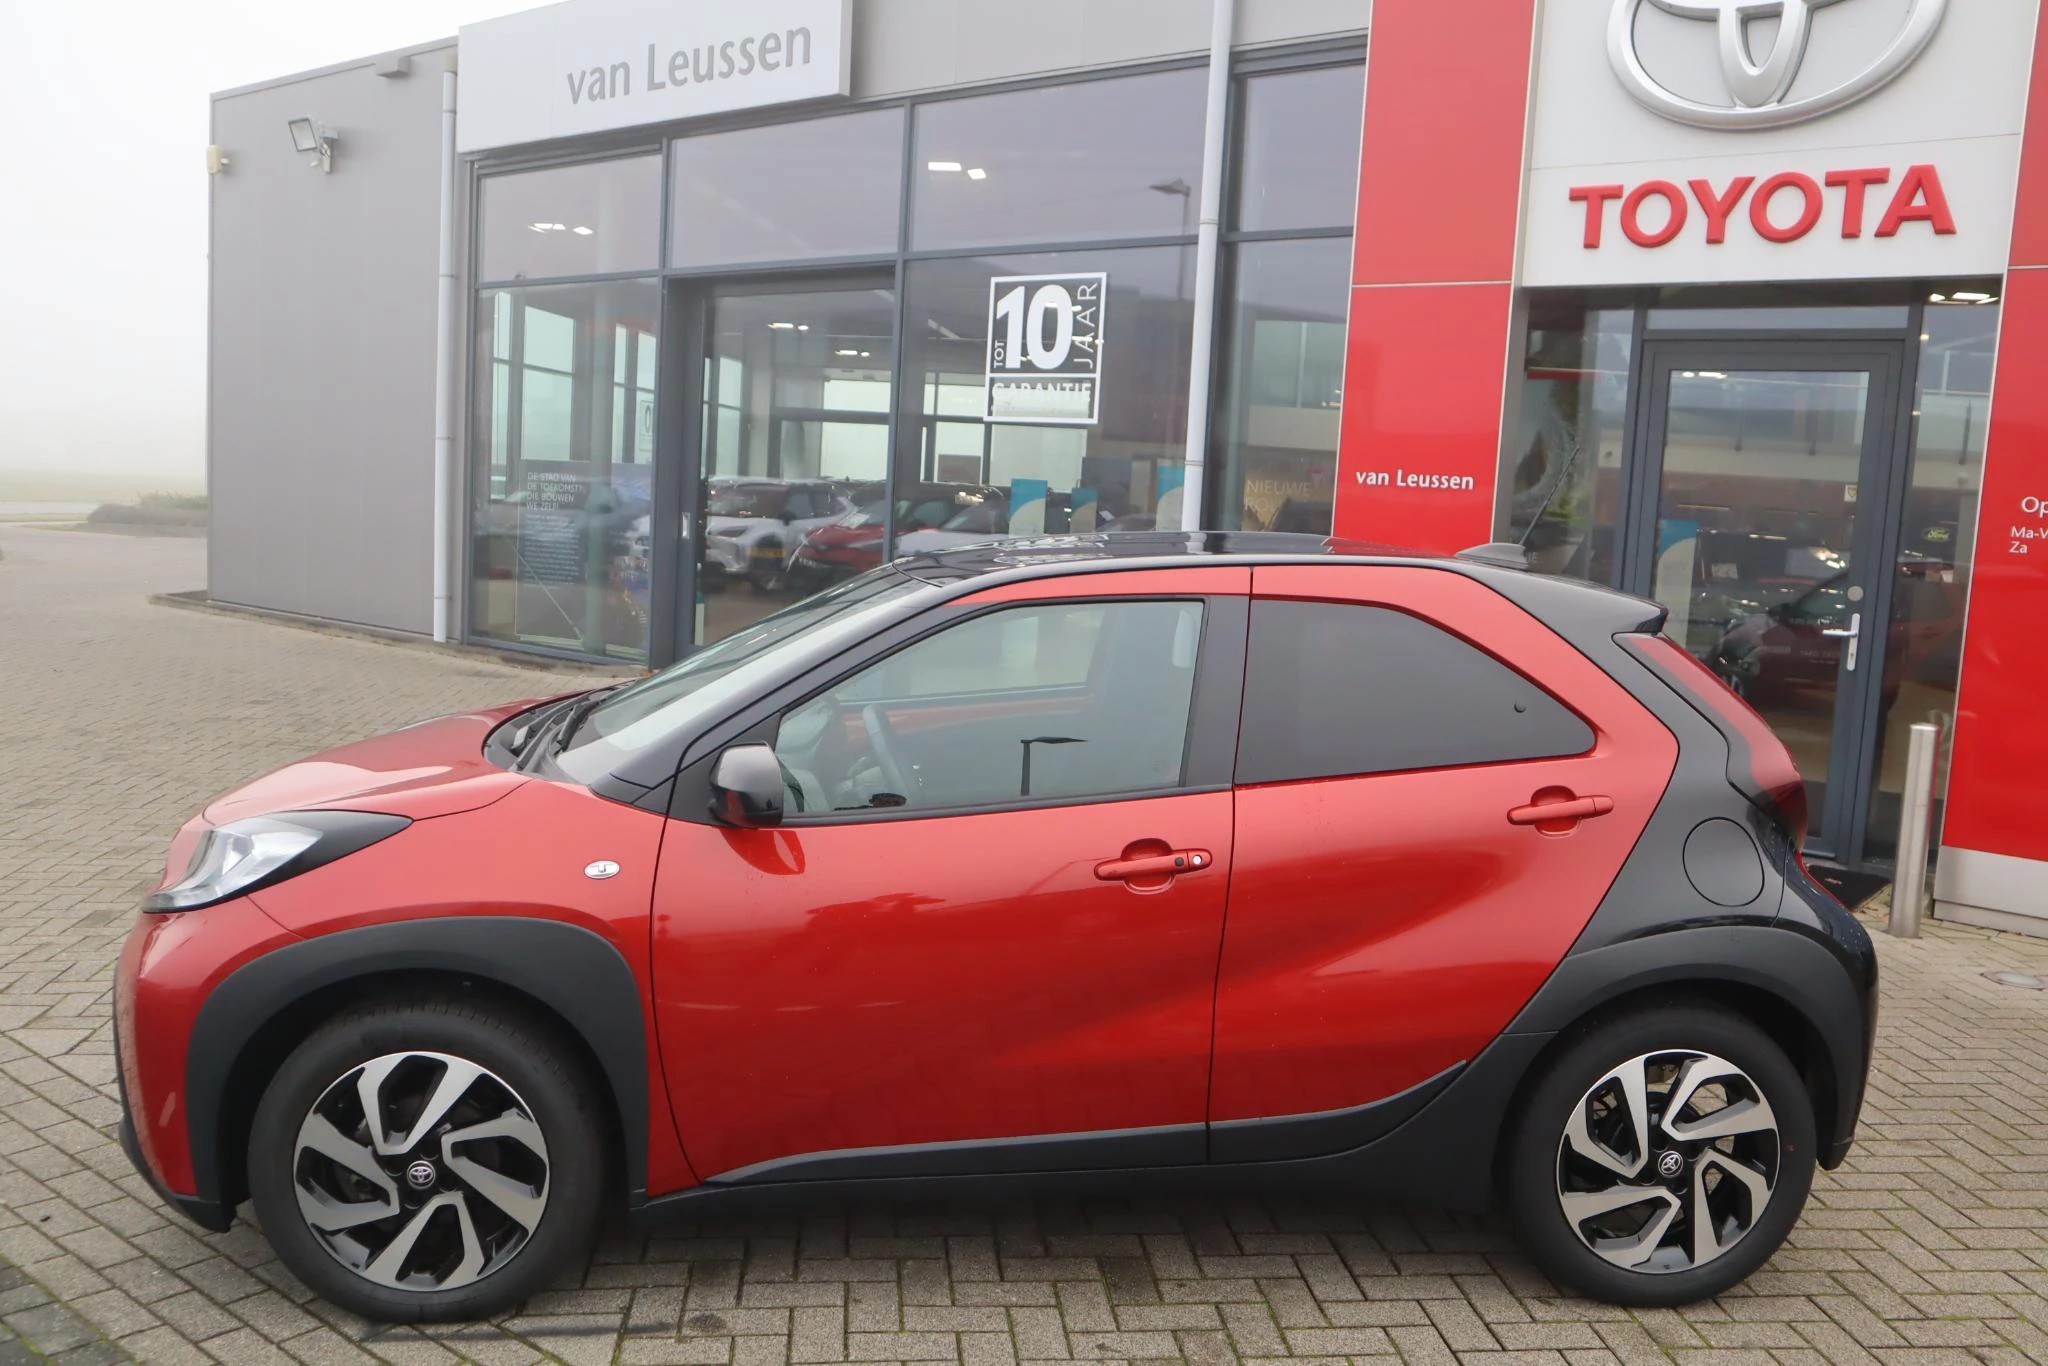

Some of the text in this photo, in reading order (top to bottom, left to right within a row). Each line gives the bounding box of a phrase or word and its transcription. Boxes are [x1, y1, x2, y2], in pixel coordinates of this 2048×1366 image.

[567, 26, 812, 105] van Leussen
[1569, 164, 1957, 249] TOYOTA
[996, 284, 1074, 370] 10
[1074, 283, 1098, 369] JAAR
[994, 340, 1005, 368] TOT
[540, 473, 559, 482] STAD
[560, 473, 576, 483] VAN
[1246, 479, 1312, 497] NIEUWE
[1356, 469, 1474, 490] van Leussen
[2008, 541, 2028, 554] Za
